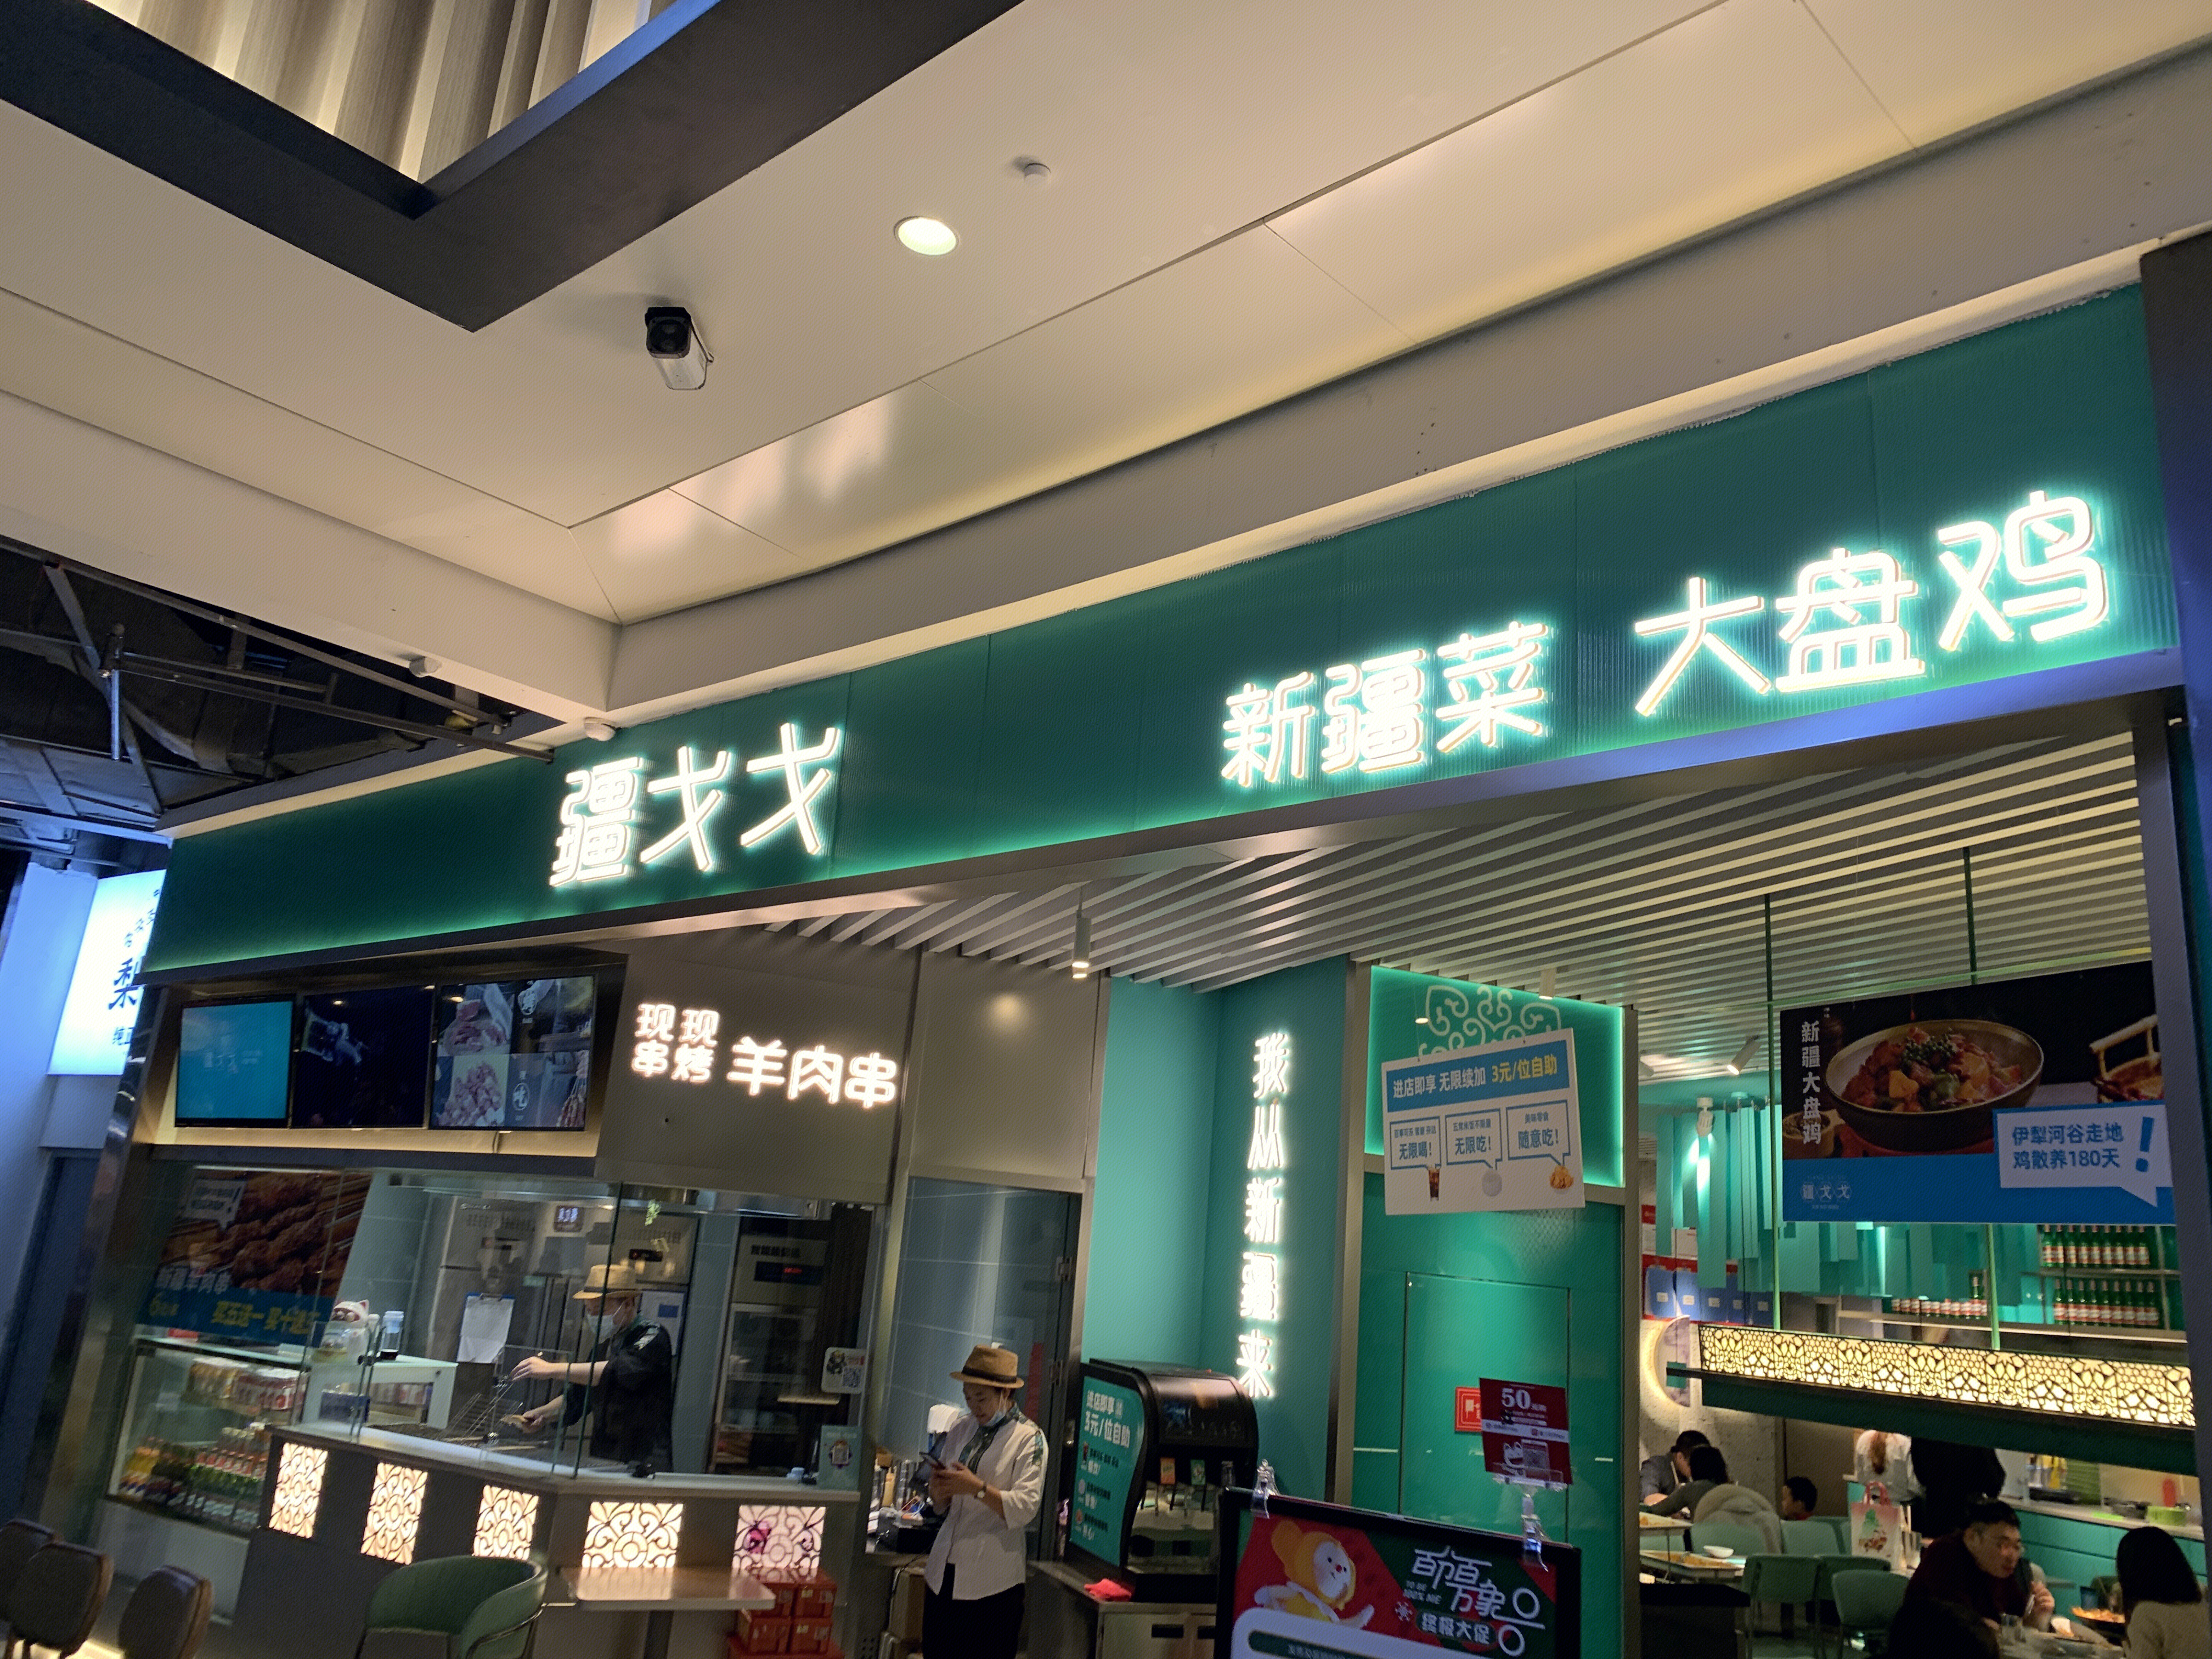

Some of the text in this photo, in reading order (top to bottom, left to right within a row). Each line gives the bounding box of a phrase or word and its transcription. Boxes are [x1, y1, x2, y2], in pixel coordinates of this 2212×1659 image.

[1635, 490, 2109, 718] 大盘鸡
[1221, 621, 1548, 787] 新疆菜
[549, 723, 840, 887] 疆戈戈
[727, 1036, 896, 1108] 羊肉串
[1393, 1054, 1558, 1098] 进店即享 无限续加 3元/位自助
[1801, 1020, 1821, 1144] 新疆大盘鸡
[2012, 1122, 2124, 1146] 伊犁河谷走地
[1237, 1032, 1290, 1397] 我从新疆来
[2013, 1148, 2120, 1170] 鸡散养180天
